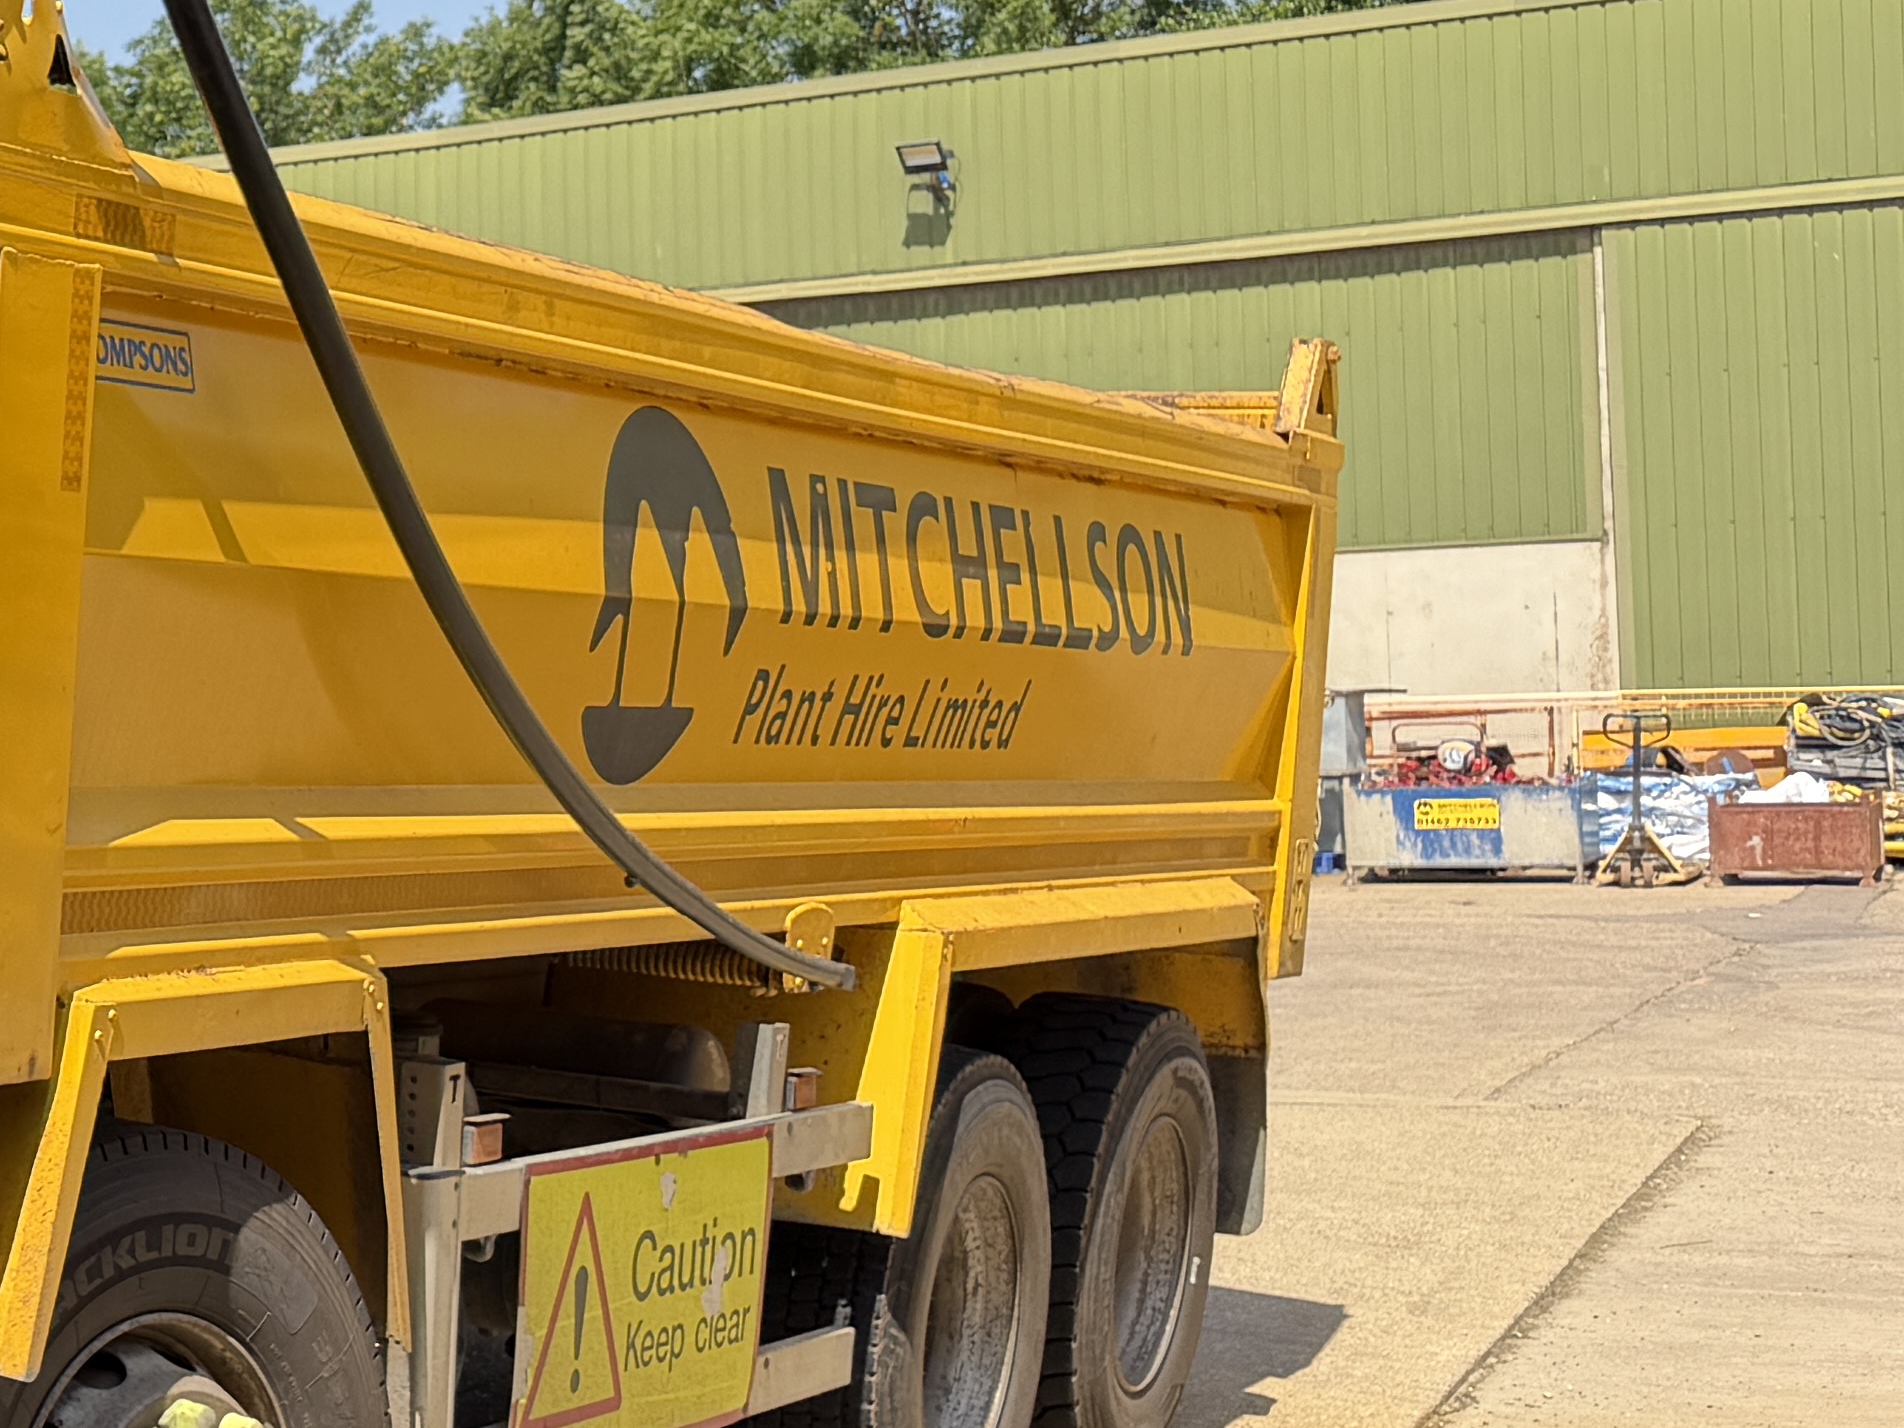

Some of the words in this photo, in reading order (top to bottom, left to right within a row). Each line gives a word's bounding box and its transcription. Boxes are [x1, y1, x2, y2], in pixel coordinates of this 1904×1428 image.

[766, 465, 1194, 657] MITCHELLSON
[731, 663, 836, 746] Plant
[829, 673, 905, 749] Hire
[901, 677, 1033, 752] Limited
[631, 1217, 757, 1302] Caution
[623, 1318, 685, 1373] Keep
[694, 1305, 751, 1354] clear
